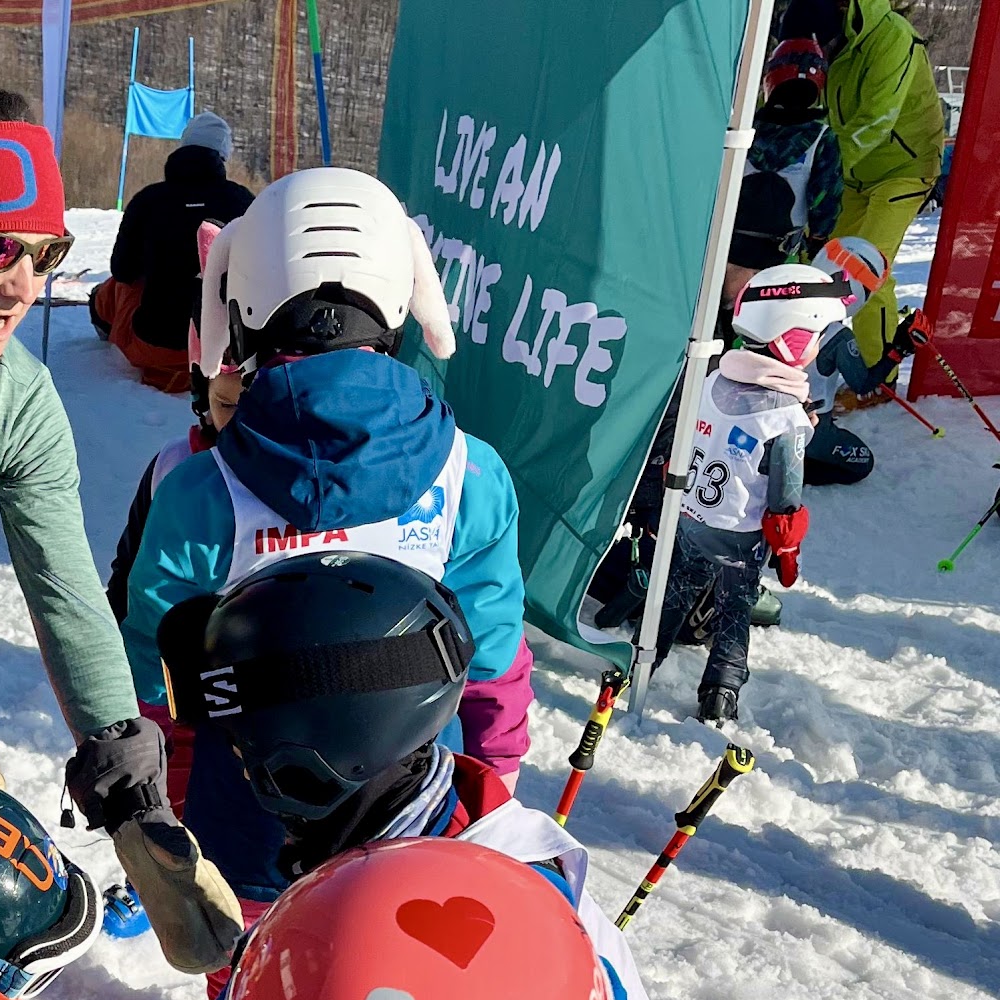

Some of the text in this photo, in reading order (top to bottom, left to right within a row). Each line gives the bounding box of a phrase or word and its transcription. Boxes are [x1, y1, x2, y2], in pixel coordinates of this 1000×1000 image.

[434, 108, 562, 233] LIVE AN
[502, 273, 628, 408] LIFE
[683, 446, 731, 509] 53
